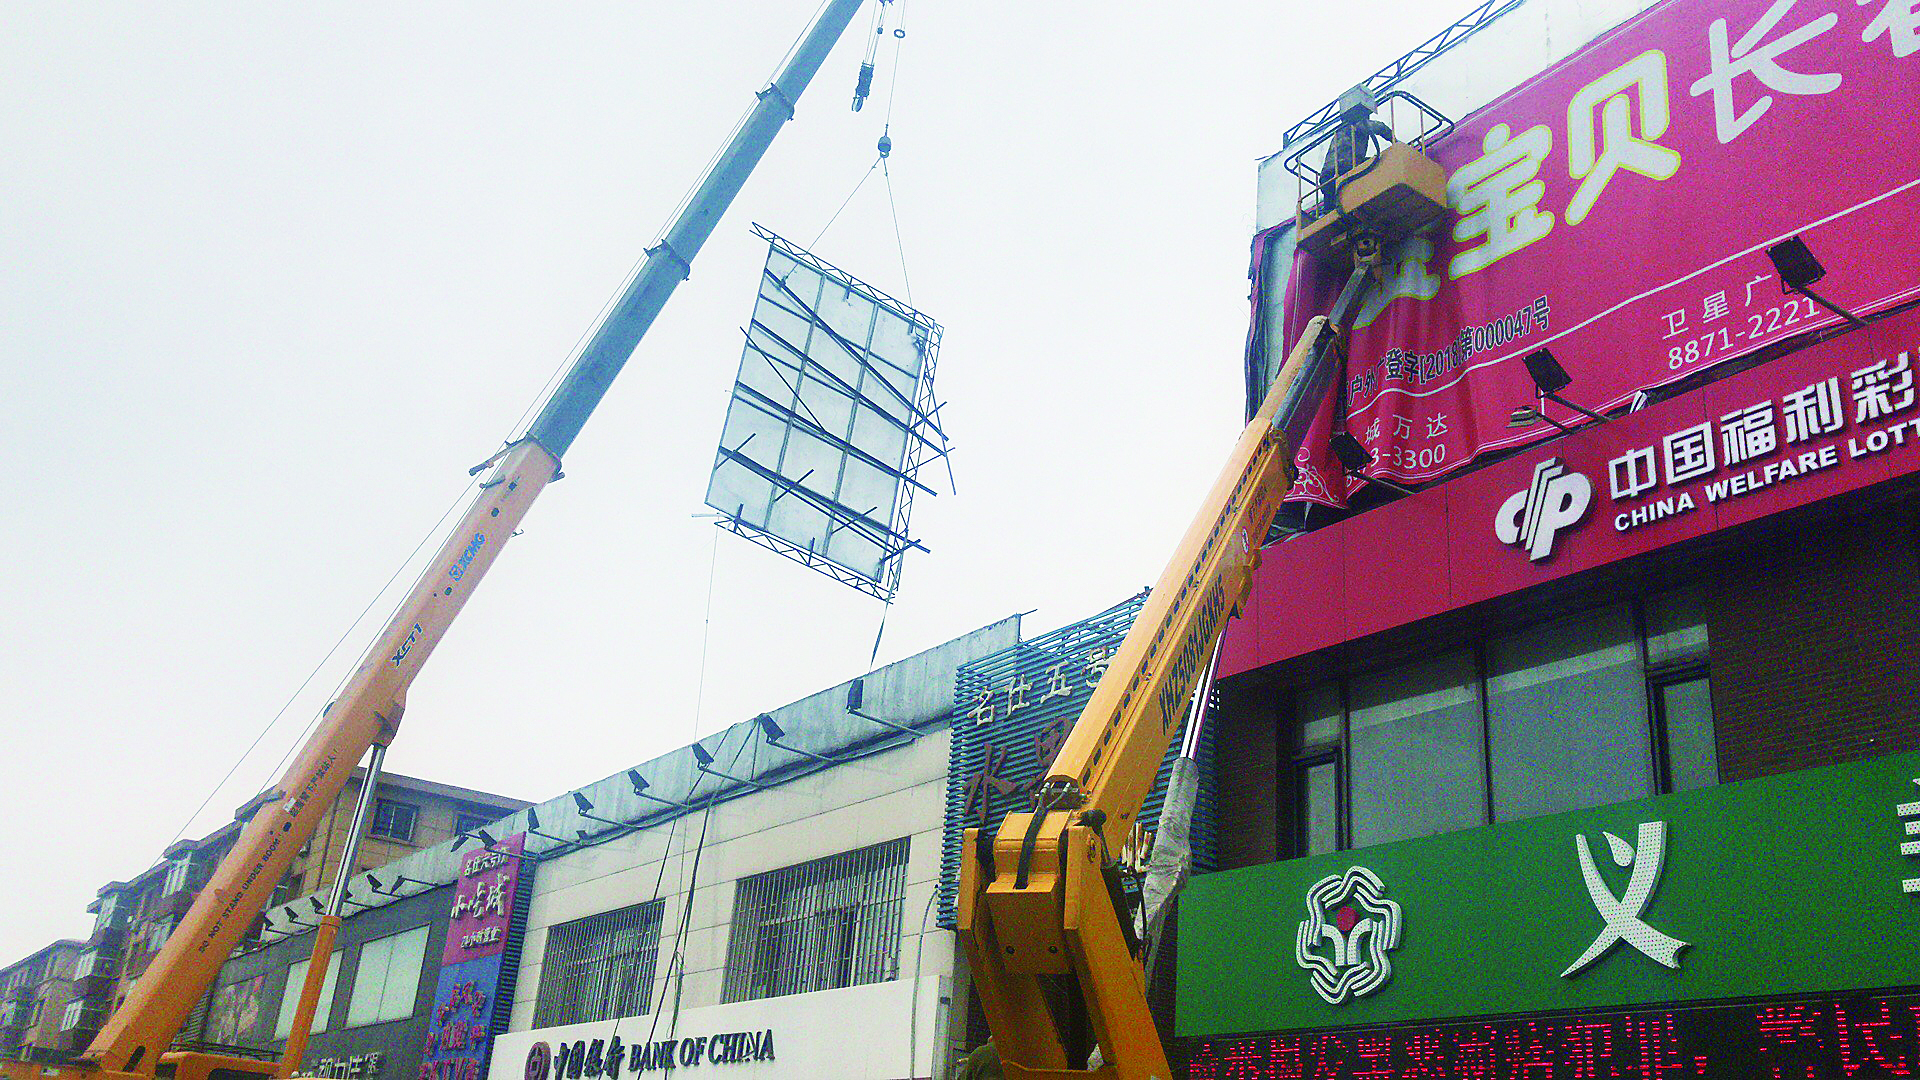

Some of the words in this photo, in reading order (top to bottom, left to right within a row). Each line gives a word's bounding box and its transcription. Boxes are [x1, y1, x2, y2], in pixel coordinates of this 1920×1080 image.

[1668, 295, 1821, 371] 8871-2221
[1607, 350, 1920, 500] 中国福利彩
[1614, 491, 1696, 531] CHINA
[1703, 445, 1839, 503] WELFARE
[391, 622, 423, 667] XCT1
[208, 918, 223, 939] NOT
[221, 891, 243, 919] STAND
[241, 862, 264, 890] UNDER
[554, 1036, 626, 1080] 中国银行
[628, 1040, 679, 1072] BANK
[679, 1037, 707, 1067] OF
[708, 1029, 776, 1065] CHINA
